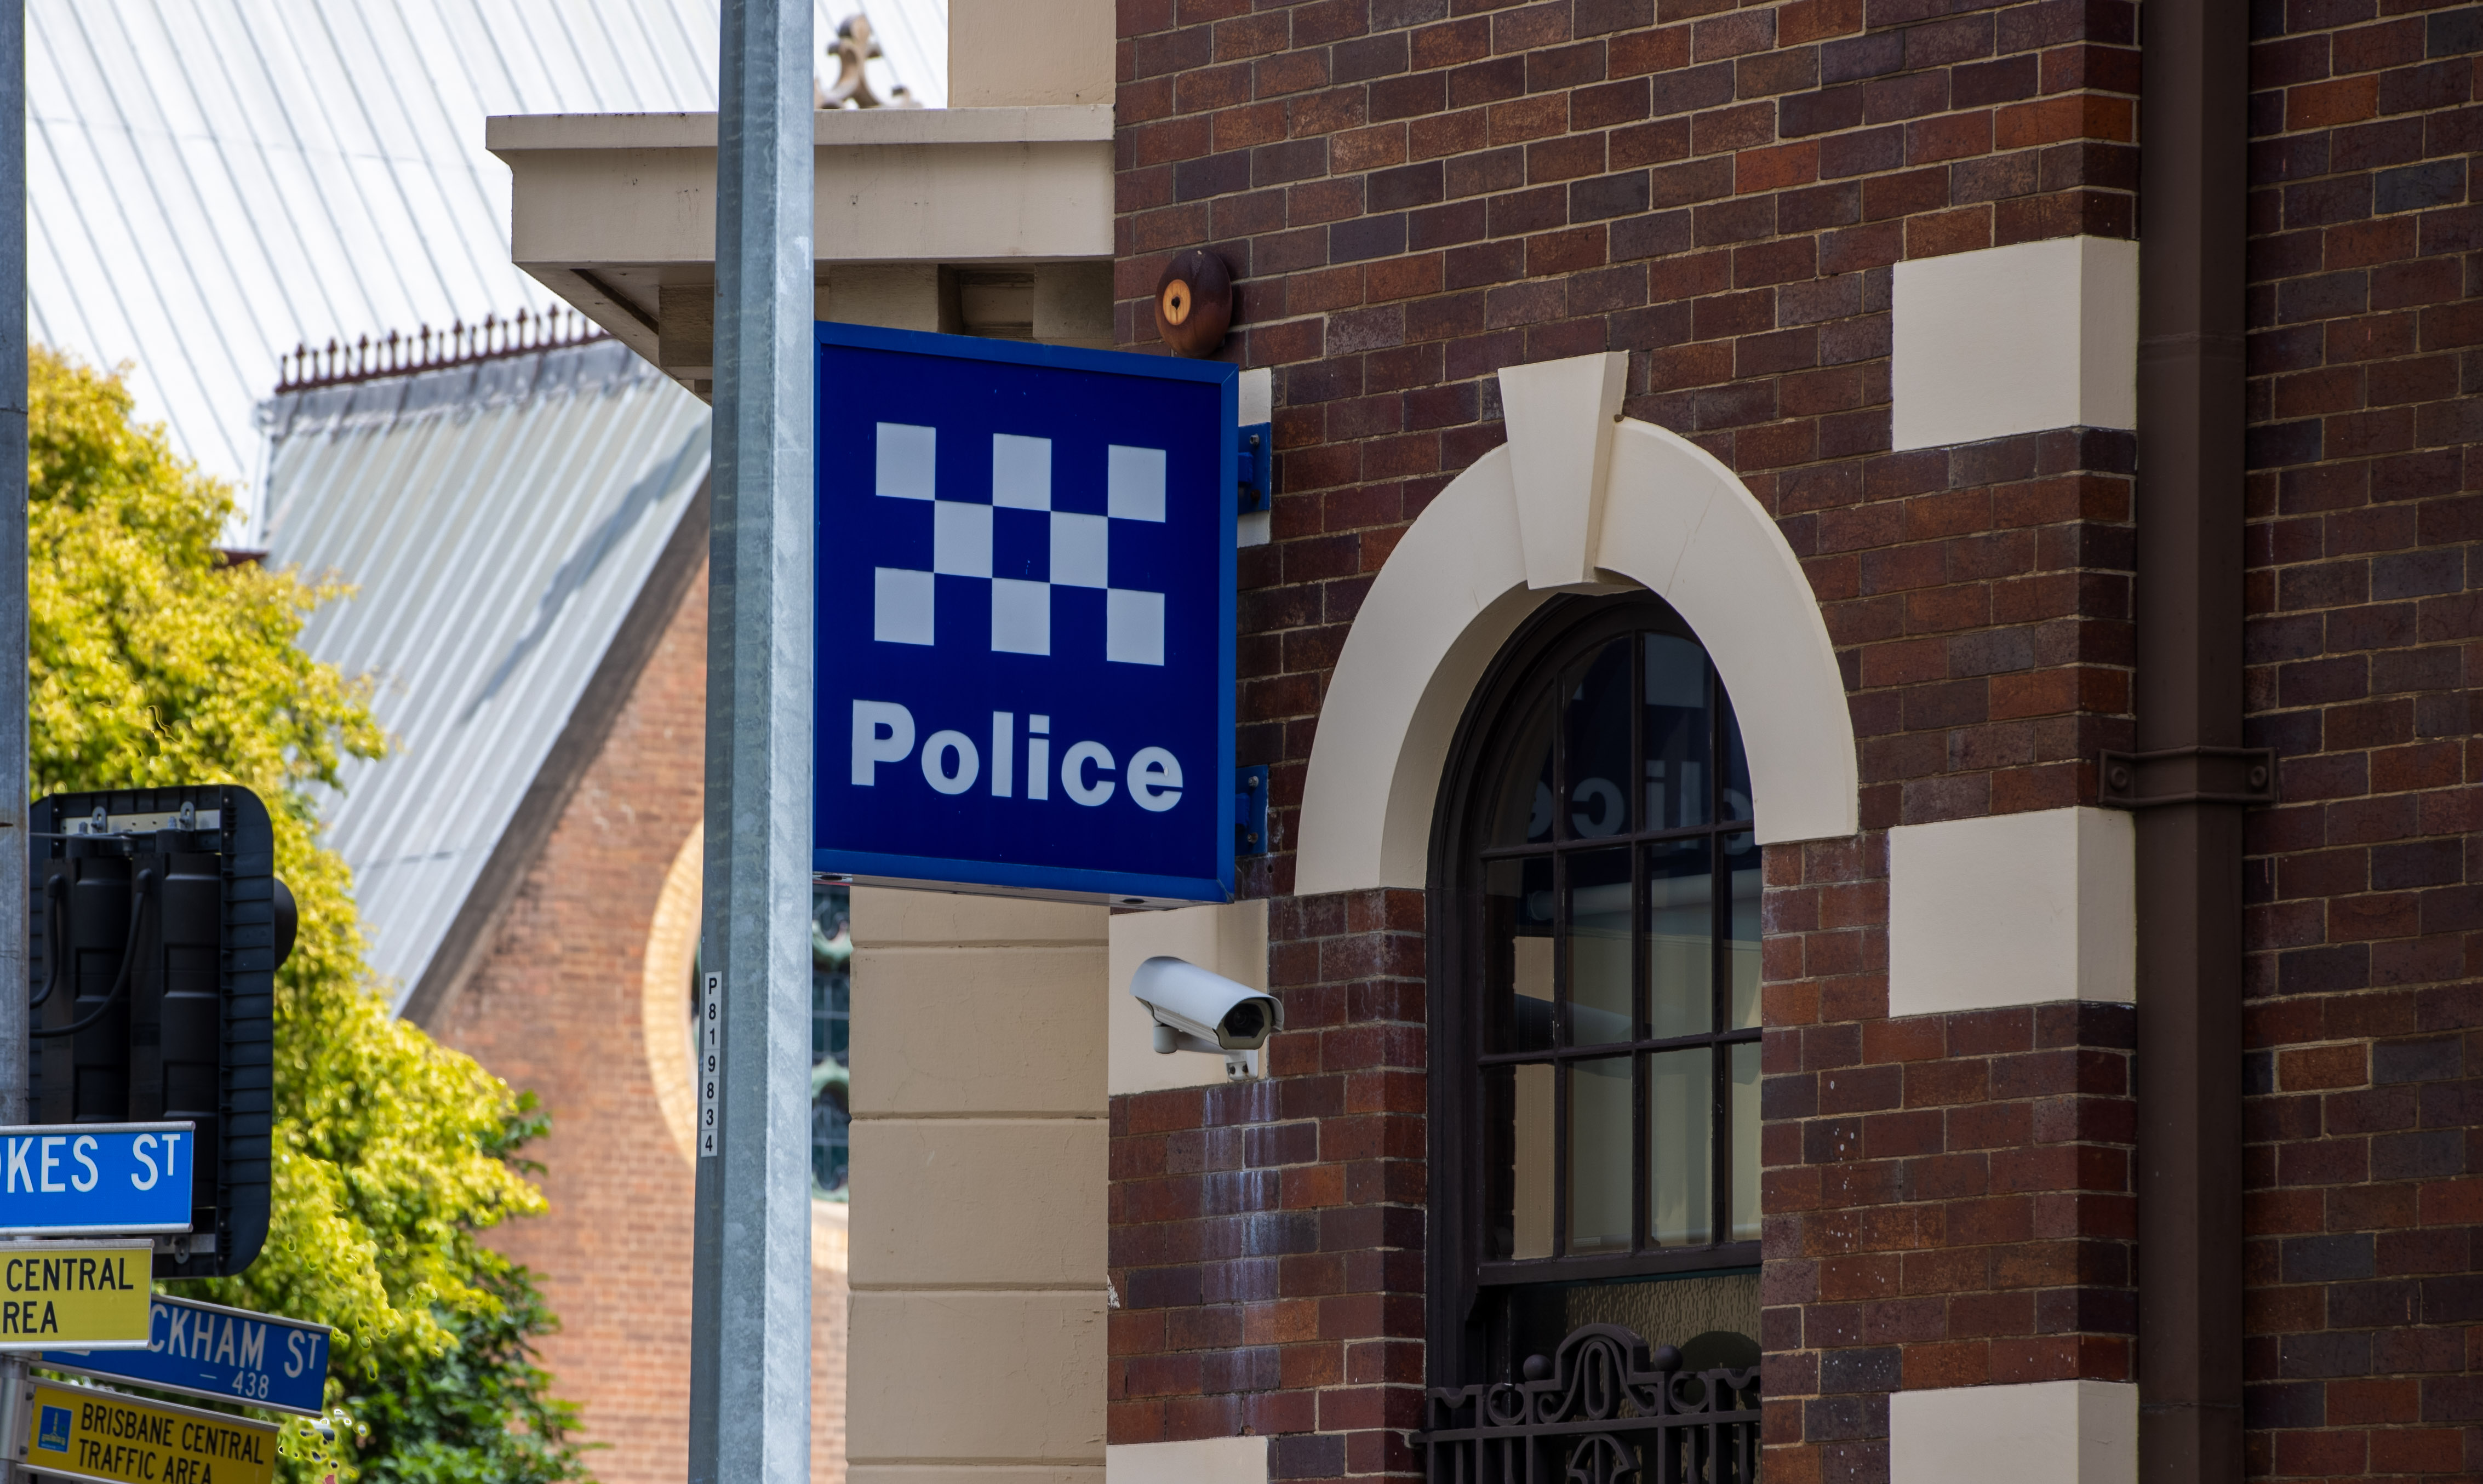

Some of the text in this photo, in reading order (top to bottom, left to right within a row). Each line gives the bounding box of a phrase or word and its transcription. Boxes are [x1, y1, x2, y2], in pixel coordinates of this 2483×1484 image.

[851, 700, 1183, 812] Police
[705, 977, 718, 1152] P819834
[0, 1133, 181, 1194] KES ST
[6, 1258, 134, 1292] CENTRAL
[0, 1301, 58, 1333] REA
[150, 1304, 321, 1378] CKHAM ST
[231, 1371, 270, 1399] 438
[79, 1439, 212, 1484] TRAFFIC AREA
[81, 1402, 264, 1465] BRISBANE CENTRAL
